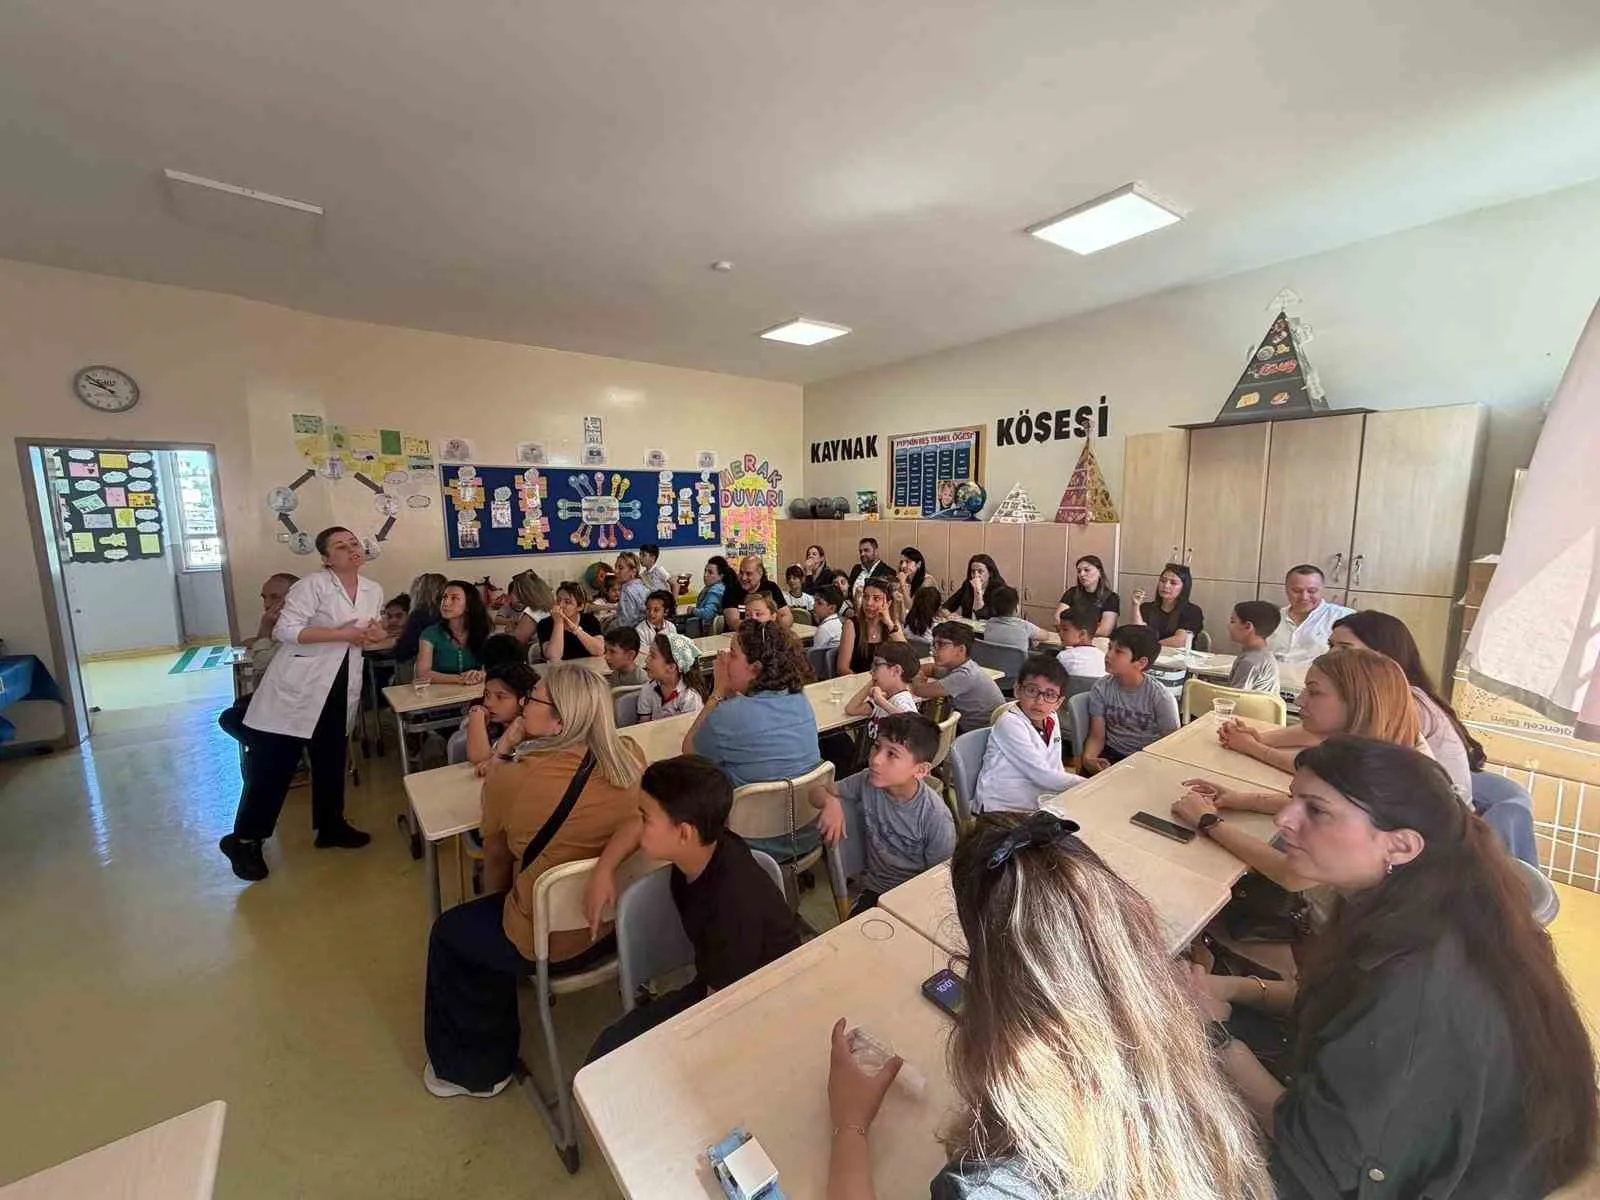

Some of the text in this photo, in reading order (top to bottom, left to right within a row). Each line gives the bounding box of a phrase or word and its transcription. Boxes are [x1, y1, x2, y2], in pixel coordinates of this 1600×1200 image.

[811, 395, 1108, 464] KAYNAK KÖŞESİ
[720, 454, 782, 489] MERAK
[720, 488, 783, 508] DUVARI
